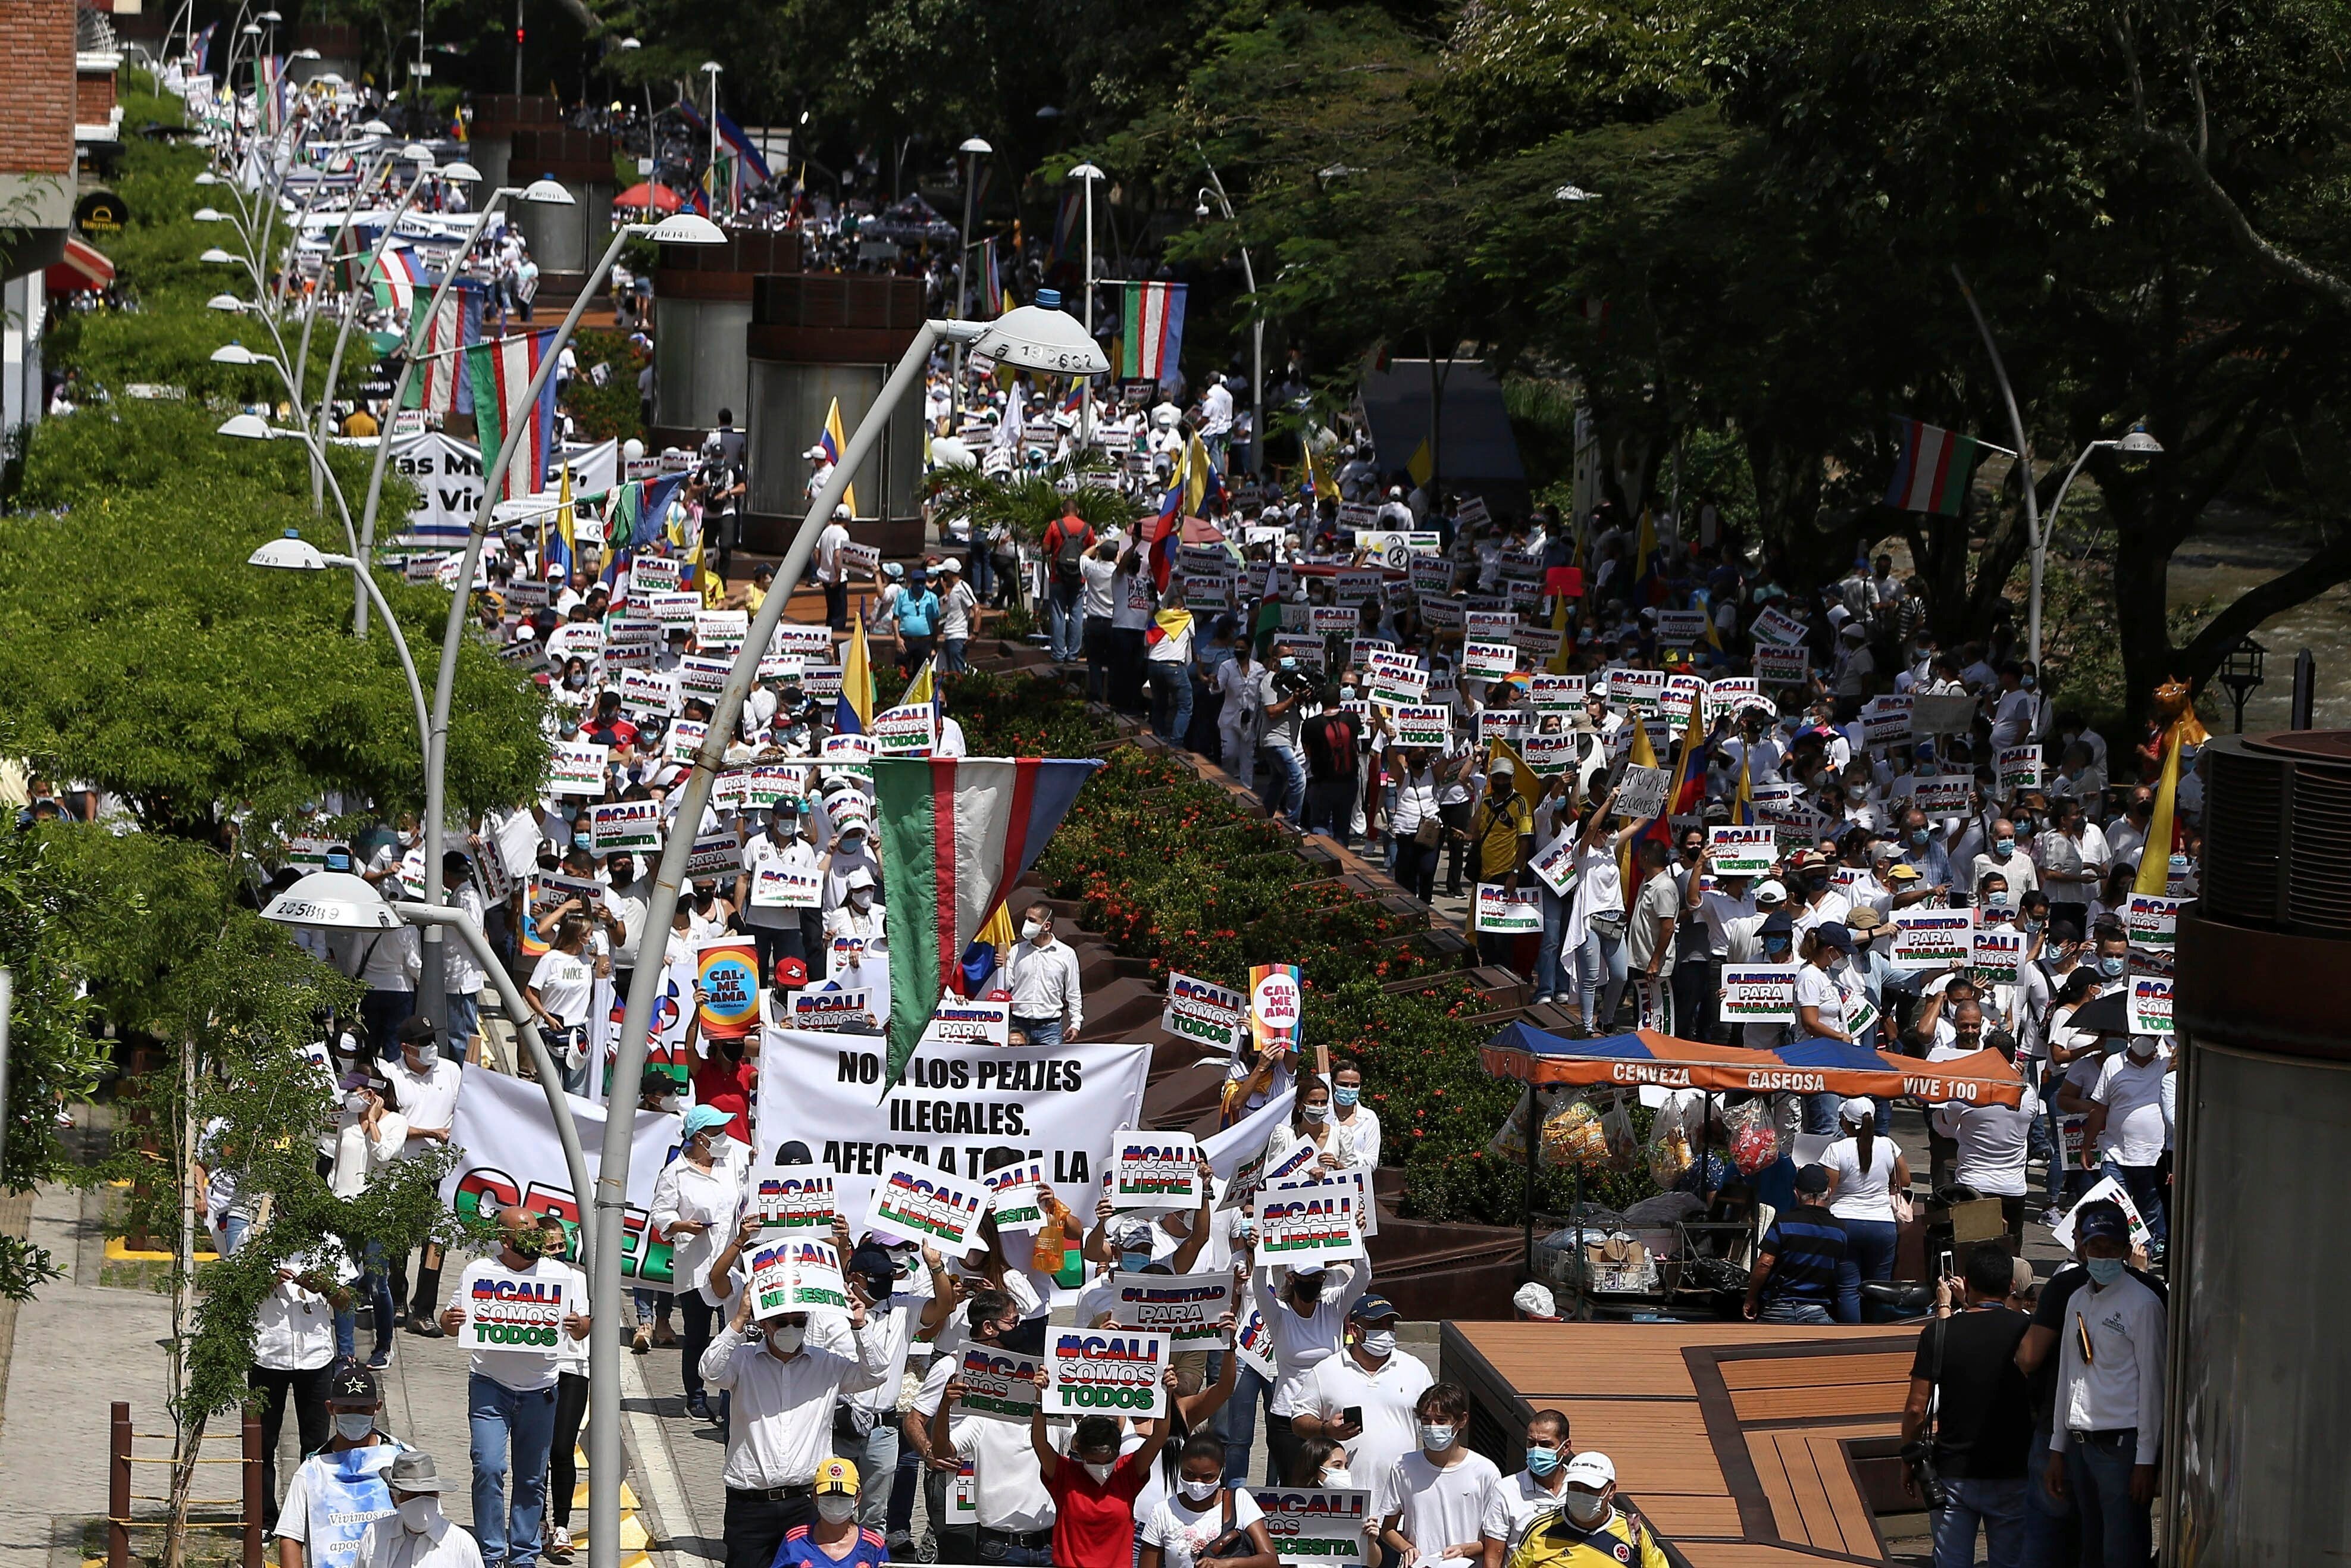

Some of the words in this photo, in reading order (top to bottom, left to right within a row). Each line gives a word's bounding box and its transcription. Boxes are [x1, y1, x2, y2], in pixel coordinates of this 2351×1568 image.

[637, 559, 674, 571] #CALI
[1314, 609, 1355, 620] #CALI
[1469, 613, 1517, 627] #CALI
[781, 632, 827, 643] #CALI
[605, 646, 650, 660] #CALI
[1467, 646, 1514, 662] #CALI
[1760, 646, 1805, 661] #CALI
[1467, 658, 1487, 668] NOS
[1761, 659, 1805, 669] SOMOS
[691, 672, 722, 684] PARA
[1379, 668, 1425, 687] #CALI
[1611, 672, 1661, 687] #CALI
[1761, 668, 1802, 680] TODOS
[625, 676, 670, 696] #CALI
[1376, 680, 1395, 690] NOS
[1532, 679, 1583, 693] #CALI
[1611, 686, 1632, 695] NOS
[1713, 681, 1754, 692] #CALI
[1532, 693, 1555, 702] NOS
[878, 708, 928, 724] #CALI
[1399, 706, 1447, 721] #CALI
[1483, 713, 1530, 728] #CALI
[877, 722, 928, 736] SOMOS
[1398, 720, 1445, 733] SOMOS
[1482, 728, 1505, 737] NOS
[879, 735, 929, 747] TODOS
[1398, 732, 1445, 743] TODOS
[1526, 734, 1575, 753] #CALI
[827, 738, 875, 755] #CALI
[1526, 754, 1551, 763] NOS
[2000, 748, 2037, 765] #CALI
[751, 766, 800, 781] #CALI
[1999, 762, 2036, 774] SOMOS
[1627, 768, 1648, 787] NO
[2000, 773, 2036, 786] TODOS
[750, 780, 800, 794] SOMOS
[1915, 783, 1969, 797] #CALI
[1915, 797, 1967, 811] LIBRE
[596, 805, 656, 824] #CALI
[1758, 808, 1812, 828] #CALI
[596, 824, 624, 836] NOS
[596, 835, 656, 847] NECESITA
[1715, 829, 1771, 847] #CALI
[1715, 847, 1739, 858] NOS
[1717, 859, 1770, 870] NECESITA
[760, 871, 817, 887] #CALI
[1480, 887, 1539, 907] #CALI
[1480, 905, 1505, 916] NOS
[1480, 917, 1540, 928] NECESITA
[1896, 918, 1968, 931] #LIBERTAD
[2130, 918, 2159, 931] NOS
[1909, 932, 1954, 946] PARA
[1895, 947, 1968, 960] TRABAJAR
[562, 968, 583, 980] NIKE
[1727, 973, 1796, 984] #LIBERTAD
[718, 981, 740, 991] ME
[1739, 986, 1784, 1000] PARA
[710, 991, 747, 1002] AMA
[796, 993, 865, 1012] #CALI
[1174, 979, 1239, 1014] #CALI
[1270, 997, 1292, 1007] ME
[1173, 999, 1235, 1029] SOMOS
[1264, 1007, 1295, 1018] AMA
[2137, 1000, 2174, 1015] SOM
[1171, 1013, 1232, 1044] TODOS
[2137, 1015, 2174, 1030] TOD
[939, 1024, 987, 1038] PARA
[838, 1051, 878, 1084] NO
[914, 1057, 969, 1089] LOS
[978, 1060, 1082, 1092] PEAJES
[1613, 1063, 1691, 1084] CERVEZA
[1748, 1071, 1825, 1092] GASEOSA
[1904, 1076, 1941, 1097] VIVE
[1947, 1080, 1977, 1100] 100
[890, 1098, 1030, 1136] ILEGALES.
[1122, 1146, 1195, 1169] #CALI
[1054, 1150, 1090, 1182] LA
[759, 1176, 832, 1204] #CALI
[1119, 1170, 1194, 1195] LIBRE
[887, 1171, 979, 1220] #CALI
[759, 1204, 834, 1228] LIBRE
[878, 1194, 969, 1243] LIBRE
[1263, 1197, 1351, 1227] #CALI
[1263, 1223, 1352, 1251] LIBRE
[753, 1242, 839, 1277] #CALI
[757, 1271, 801, 1292] NOS
[472, 1278, 561, 1306] #CALI
[761, 1287, 846, 1309] NECESITA
[1121, 1286, 1226, 1303] #LIBERTAD
[474, 1304, 559, 1326] SOMOS
[1138, 1305, 1204, 1323] PARA
[474, 1323, 558, 1345] TODOS
[1056, 1334, 1159, 1364] #CALI
[1059, 1364, 1156, 1386] SOMOS
[963, 1377, 1008, 1397] NOS
[1057, 1386, 1154, 1410] TODOS
[1253, 1492, 1363, 1519] #CALI
[330, 1512, 379, 1525] Vivimos
[330, 1541, 361, 1553] apoc
[1271, 1537, 1359, 1557] ECESITA
